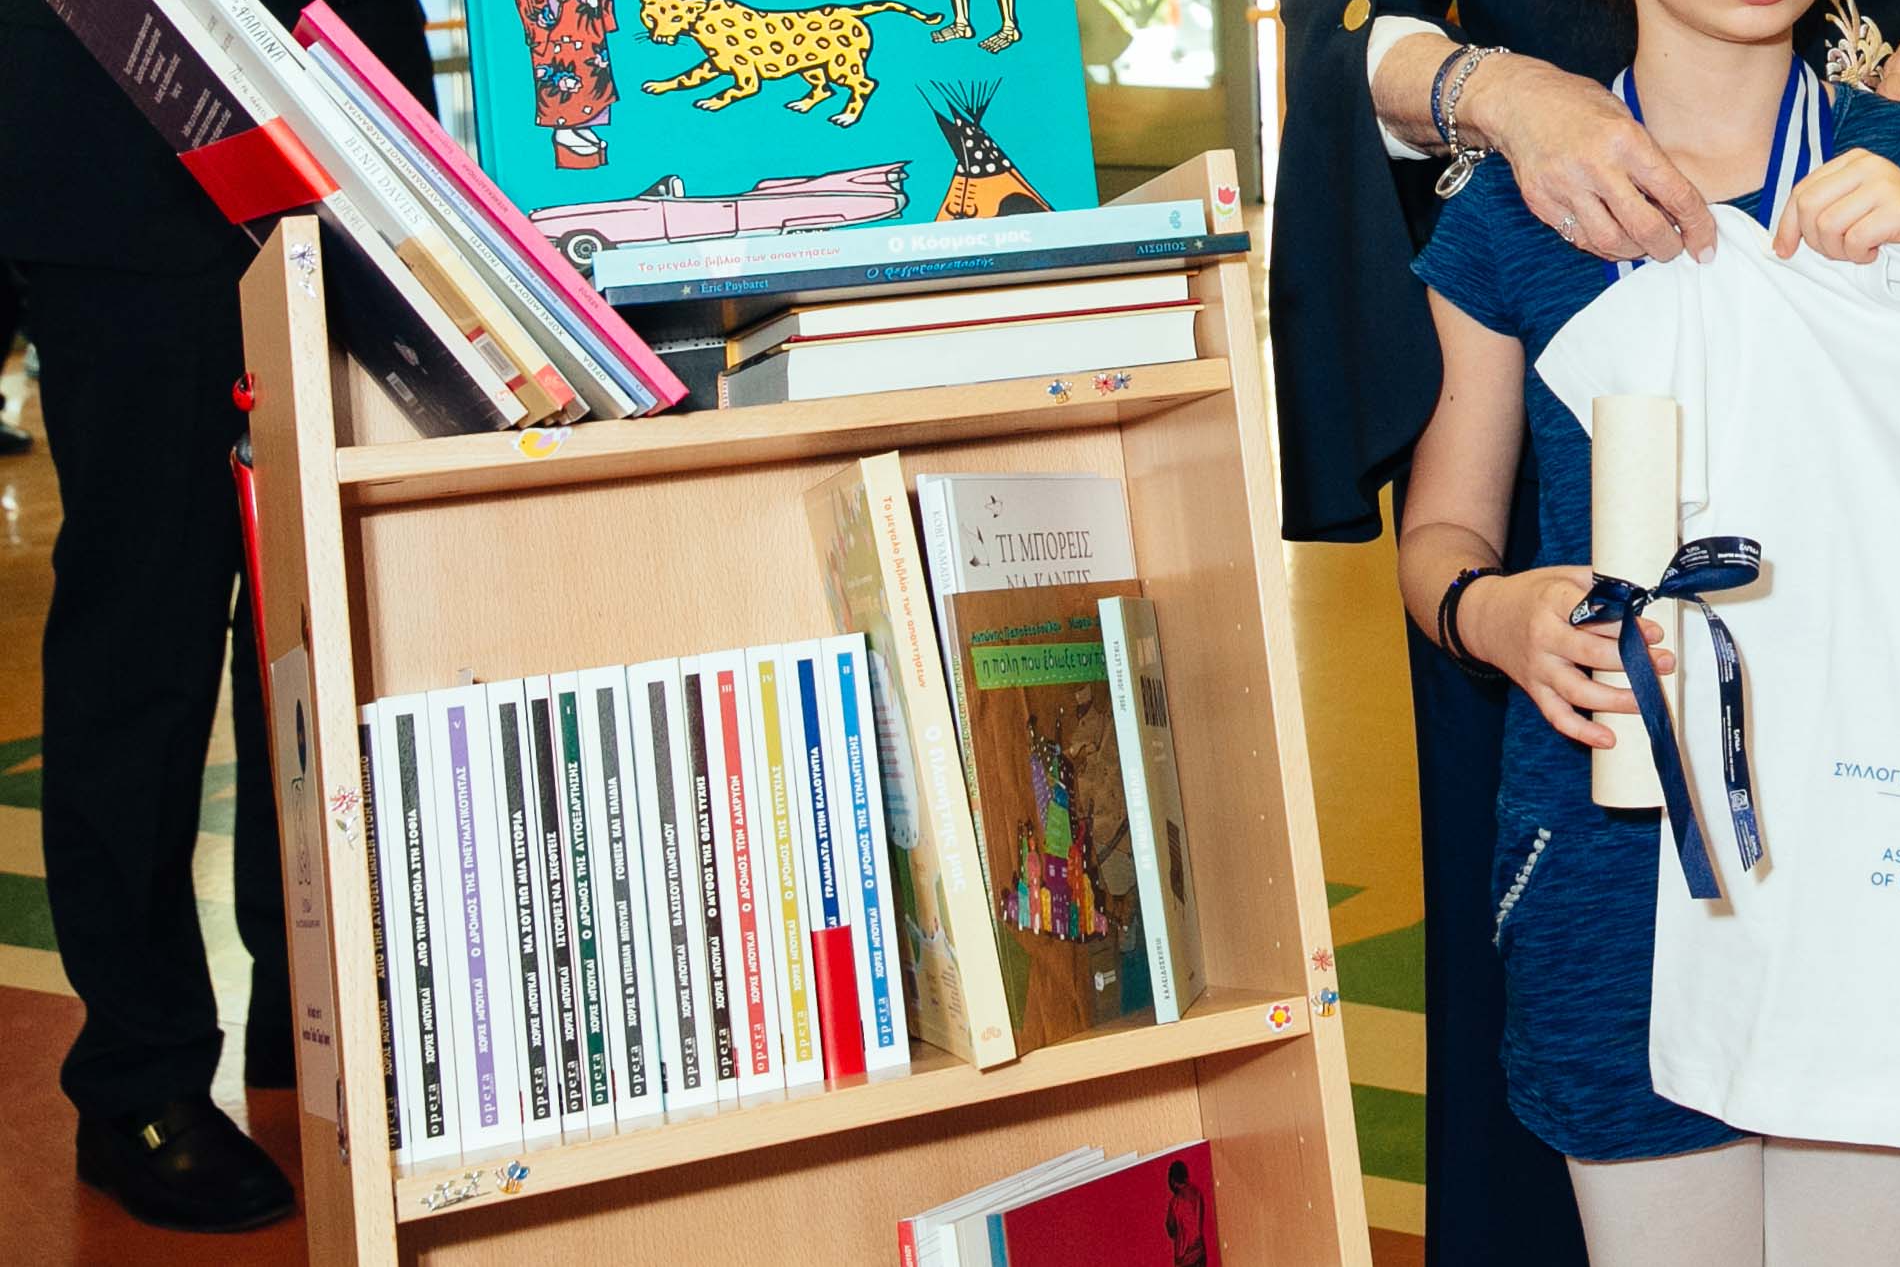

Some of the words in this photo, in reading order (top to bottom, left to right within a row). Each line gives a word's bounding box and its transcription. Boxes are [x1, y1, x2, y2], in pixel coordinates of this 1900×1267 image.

[376, 174, 423, 225] DAVIES
[995, 534, 1016, 563] ΤΙ
[1018, 531, 1093, 562] ΜΠΟΡΕΙΣ
[809, 746, 825, 808] ΚΛΑΟΥΝΤΙΑ
[849, 734, 865, 804] ΣΥΝΑΝΤΗΣΗΣ
[567, 761, 585, 851] ΑΥΤΟΕΞΑΡΤΗΣΗΣ
[607, 776, 620, 814] ΠΑΙΔΙΑ
[696, 775, 708, 810] ΤΥΧΗΣ
[729, 774, 744, 825] ΔΑΚΡΥΩΝ
[771, 764, 785, 815] ΕΥΤΥΧΙΑΣ
[407, 808, 419, 845] ΣΟΦΙΑ
[456, 765, 473, 868] ΠΝΕΥΜΑΤΙΚΟΤΗΤΑΣ
[512, 810, 525, 858] ΙΣΤΟΡΙΑ
[611, 818, 621, 837] ΚΑΙ
[664, 822, 675, 845] ΜΟΥ
[699, 811, 711, 841] ΘΕΑΣ
[776, 818, 788, 840] ΤΗΣ
[816, 810, 828, 838] ΣΤΗΝ
[856, 807, 868, 829] ΤΗΣ
[410, 847, 421, 869] ΣΤΗ
[546, 831, 560, 880] ΣΚΕΦΤΕΙΣ
[701, 843, 713, 865] ΤΗΣ
[735, 828, 746, 851] ΤΩΝ
[859, 832, 873, 876] ΔΡΟΜΟΣ
[516, 859, 528, 883] ΜΙΑ
[575, 855, 587, 877] ΤΗΣ
[612, 841, 625, 880] ΓΟΝΕΙΣ
[666, 846, 678, 878] ΠΑΝΩ
[737, 853, 751, 899] ΔΡΟΜΟΣ
[779, 843, 792, 887] ΔΡΟΜΟΣ
[819, 840, 834, 897] ΓΡΑΜΜΑΤΑ
[1871, 871, 1895, 886] OF
[412, 871, 424, 913] ΑΓΝΟΙΑ
[464, 872, 475, 894] ΤΗΣ
[518, 885, 529, 905] ΠΩ
[551, 881, 562, 898] ΝΑ
[577, 879, 591, 926] ΔΡΟΜΟΣ
[669, 879, 683, 925] ΒΑΣΙΣΟΥ
[703, 866, 716, 906] ΜΥΘΟΣ
[783, 890, 793, 900] Ο
[864, 879, 874, 888] Ο
[466, 897, 479, 943] ΔΡΟΜΟΣ
[520, 908, 531, 932] ΣΟΥ
[552, 899, 566, 947] ΙΣΤΟΡΙΕΣ
[617, 900, 630, 941] ΜΠΟΥΚΑΪ
[707, 908, 717, 917] Ο
[741, 902, 752, 911] Ο
[415, 915, 426, 940] ΤΗΝ
[522, 933, 533, 953] ΝΑ
[582, 929, 592, 939] Ο
[786, 919, 799, 960] ΜΠΟΥΚΑΪ
[867, 906, 881, 947] ΜΠΟΥΚΑΪ
[417, 942, 428, 966] ΑΠΟ
[470, 947, 480, 957] Ο
[621, 943, 633, 983] ΝΤΕΜΙΑΝ
[675, 944, 688, 986] ΜΠΟΥΚΑΪ
[709, 935, 722, 977] ΜΠΟΥΚΑΪ
[744, 931, 758, 972] ΜΠΟΥΚΑΪ
[872, 949, 885, 977] ΧΟΡΧΕ
[526, 971, 539, 1014] ΜΠΟΥΚΑΪ
[558, 965, 572, 1009] ΜΠΟΥΚΑΪ
[584, 958, 597, 1001] ΜΠΟΥΚΑΪ
[625, 986, 634, 994] &
[713, 979, 725, 1008] ΧΟΡΧΕ
[748, 975, 760, 1003] ΧΟΡΧΕ
[790, 963, 802, 990] ΧΟΡΧΕ
[420, 987, 432, 1030] ΜΠΟΥΚΑΪ
[473, 977, 486, 1020] ΜΠΟΥΚΑΪ
[588, 1003, 600, 1033] ΧΟΡΧΕ
[625, 997, 637, 1026] ΧΟΡΧΕ
[679, 989, 691, 1017] ΧΟΡΧΕ
[476, 1022, 488, 1053] ΧΟΡΧΕ
[529, 1016, 541, 1047] ΧΟΡΧΕ
[562, 1011, 574, 1040] ΧΟΡΧΕ
[795, 1010, 811, 1058] opera
[877, 996, 893, 1044] opera
[423, 1033, 435, 1063] ΧΟΡΧΕ
[683, 1036, 698, 1085] opera
[718, 1027, 732, 1076] opera
[753, 1022, 768, 1071] opera
[566, 1060, 582, 1110] opera
[592, 1053, 607, 1102] opera
[630, 1044, 645, 1094] opera
[427, 1083, 442, 1134] opera
[481, 1073, 496, 1123] opera
[532, 1065, 548, 1116] opera
